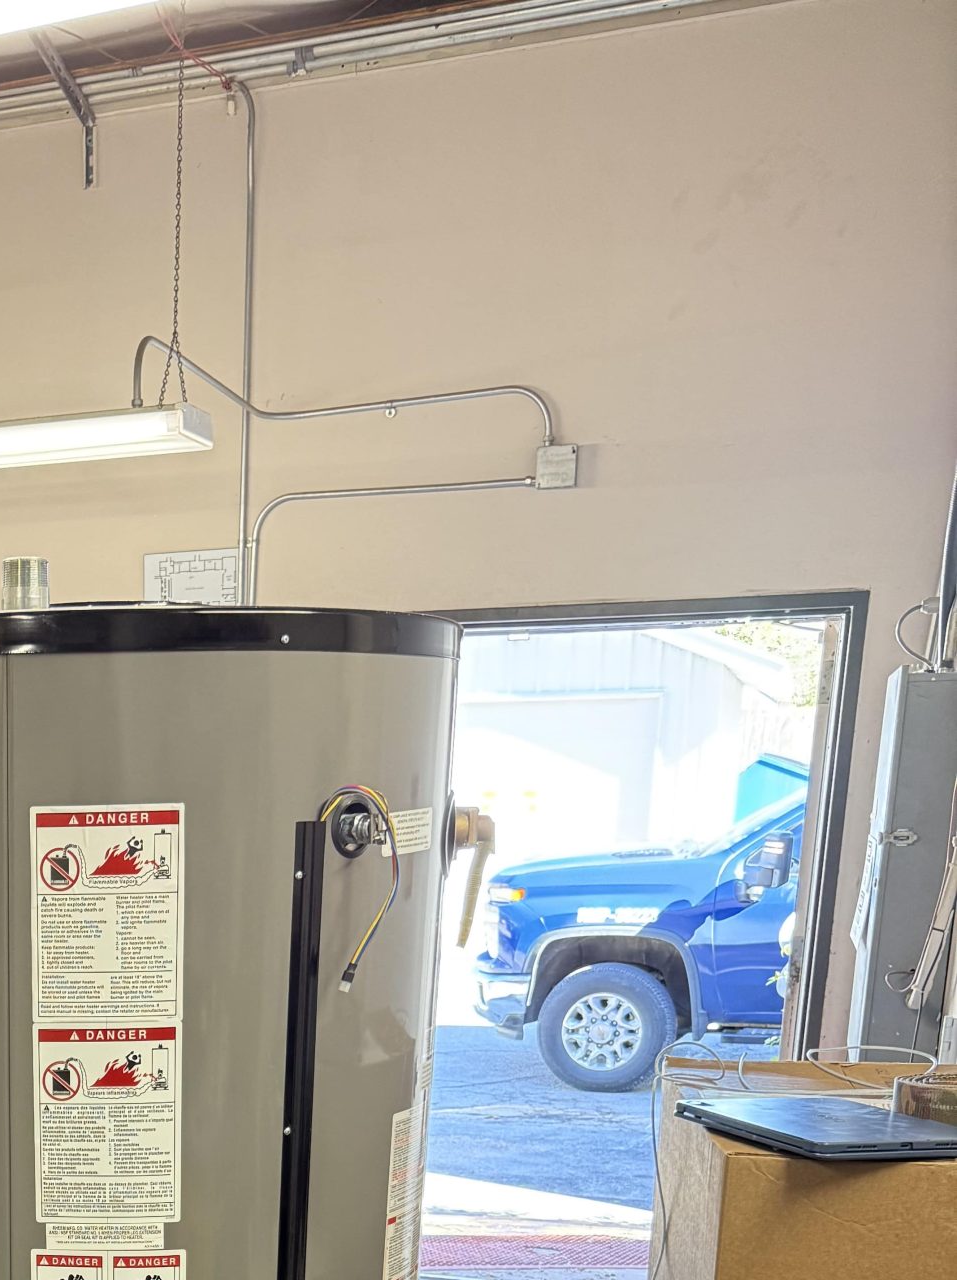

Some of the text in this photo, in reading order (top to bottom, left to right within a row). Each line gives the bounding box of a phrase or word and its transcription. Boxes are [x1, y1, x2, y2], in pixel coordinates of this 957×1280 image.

[86, 812, 149, 824] DANGER
[86, 1030, 147, 1040] DANGER
[52, 1257, 99, 1266] DANGER
[129, 1258, 176, 1267] DANGER
